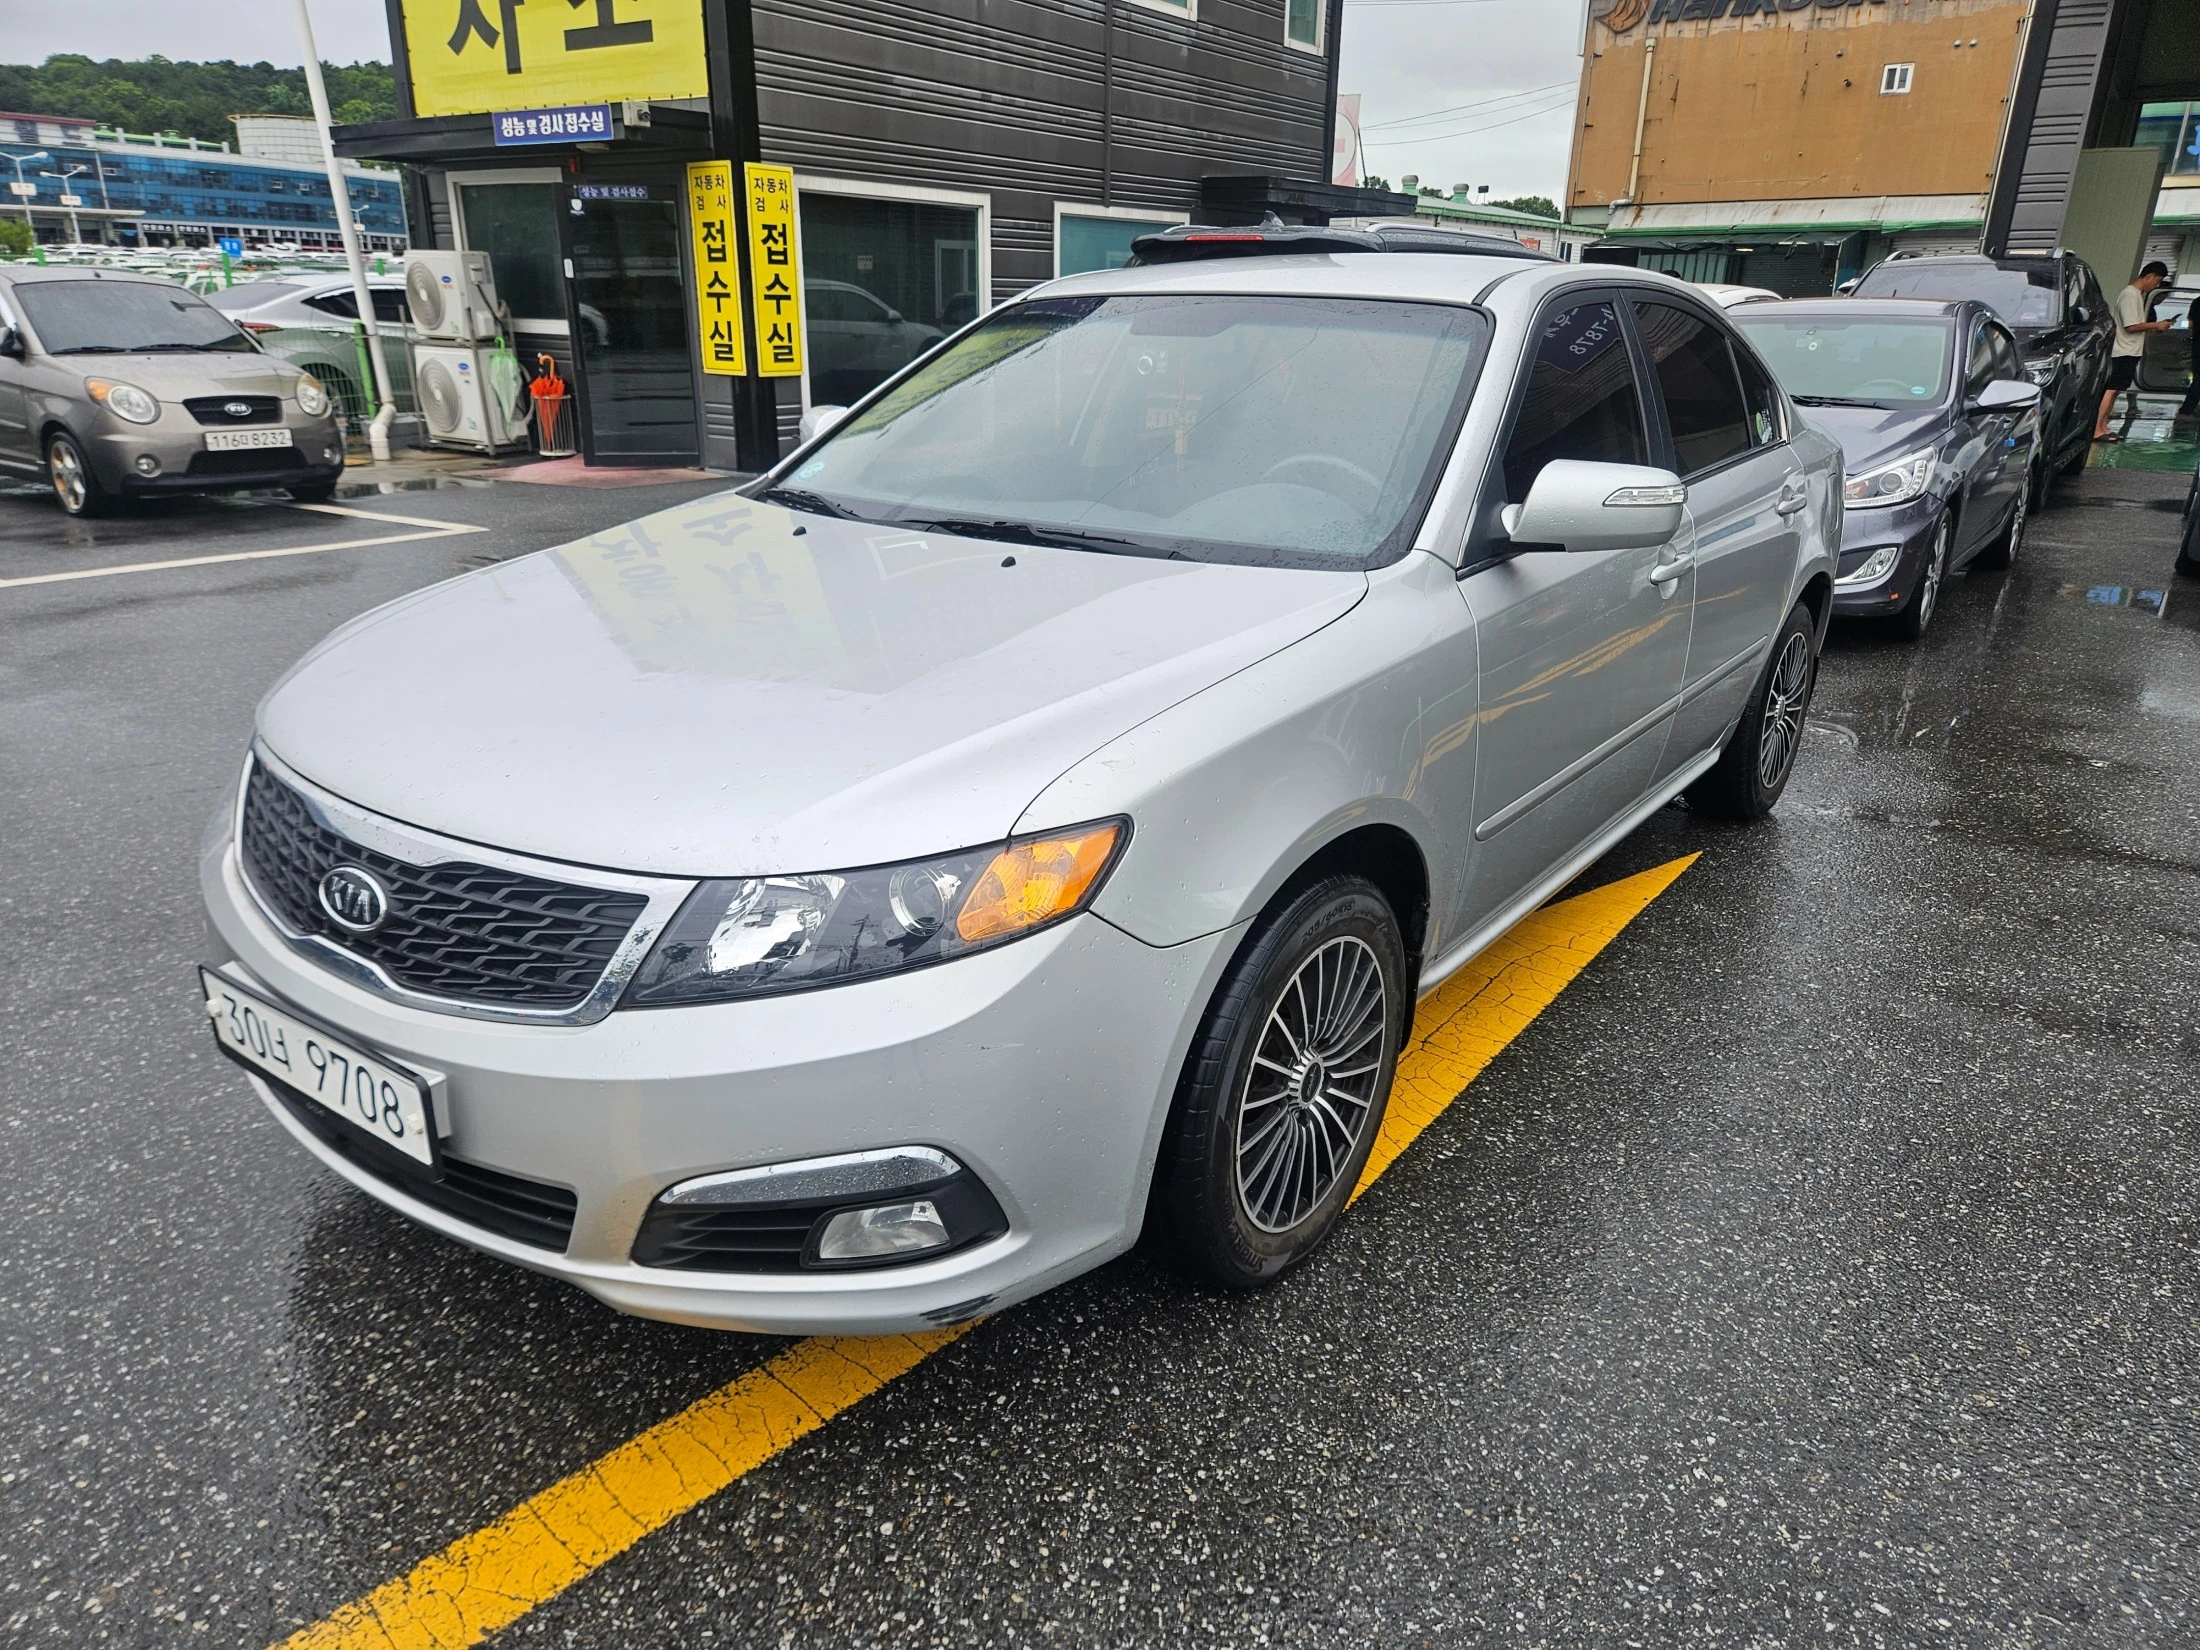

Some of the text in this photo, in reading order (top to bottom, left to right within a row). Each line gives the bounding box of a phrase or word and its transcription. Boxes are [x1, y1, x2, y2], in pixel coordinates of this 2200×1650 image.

[501, 117, 526, 137] 성능
[526, 119, 538, 135] 및
[694, 174, 725, 190] 자동차
[754, 177, 787, 194] 자동차
[702, 220, 734, 362] 접수실
[761, 223, 794, 363] 접수실
[252, 431, 286, 446] 8232
[331, 876, 372, 923] KIA
[222, 993, 404, 1138] 30너 9708
